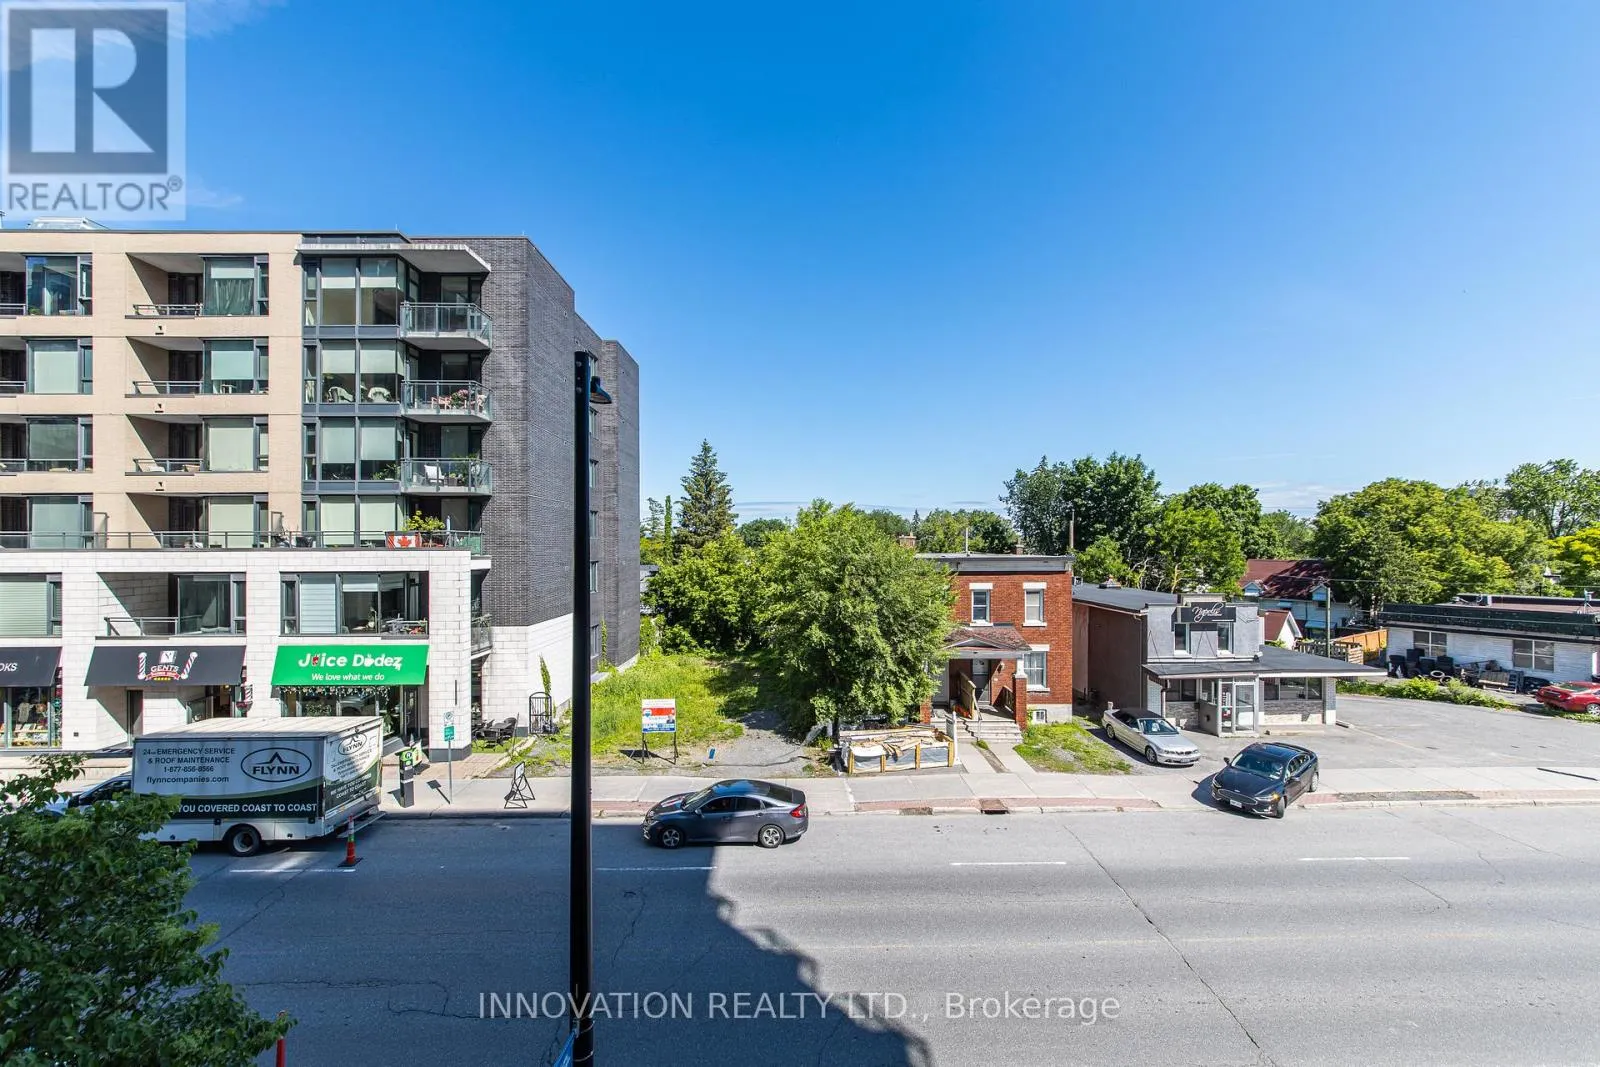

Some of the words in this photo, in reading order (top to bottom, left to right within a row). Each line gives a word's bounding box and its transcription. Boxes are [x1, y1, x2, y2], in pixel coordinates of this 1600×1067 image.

[311, 673, 324, 681] We
[325, 673, 341, 681] love
[342, 673, 361, 681] what
[374, 673, 385, 681] do
[342, 741, 363, 753] FLYNN
[177, 756, 230, 764] MAINTENANCE
[252, 765, 300, 775] FLYNN
[146, 775, 229, 784] flynncompanies.com
[197, 803, 240, 813] COVERED
[241, 803, 271, 812] COAST
[274, 803, 286, 812] TO
[287, 803, 317, 812] COAST
